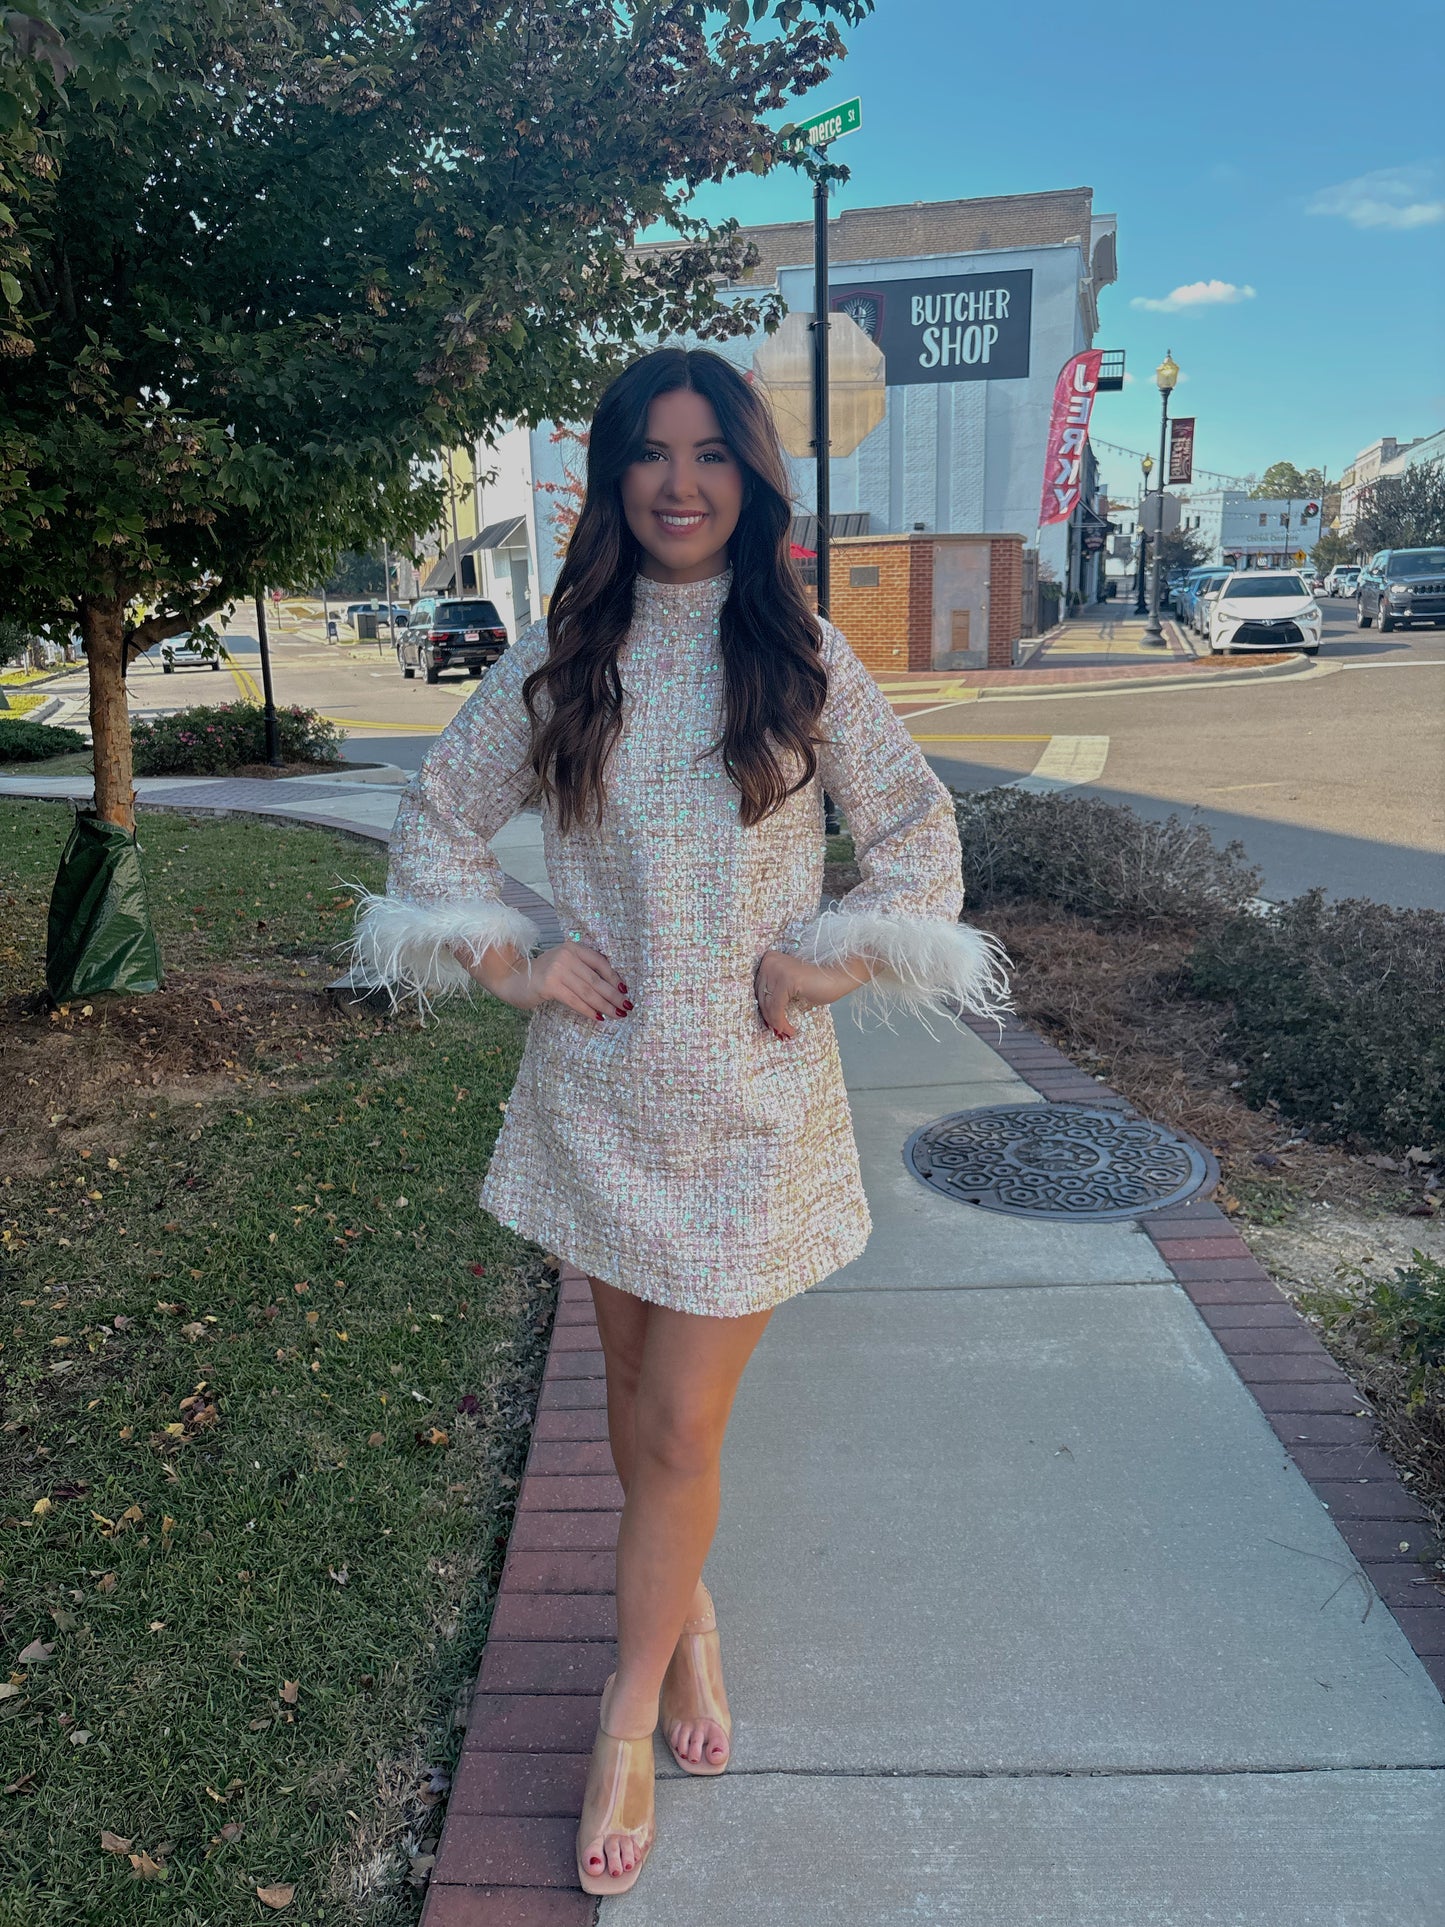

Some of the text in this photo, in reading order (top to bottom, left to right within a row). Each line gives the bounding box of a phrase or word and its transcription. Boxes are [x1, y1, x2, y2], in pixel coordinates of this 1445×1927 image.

[848, 109, 855, 122] St
[911, 289, 1010, 326] BUTCHER
[919, 324, 999, 368] SHOP
